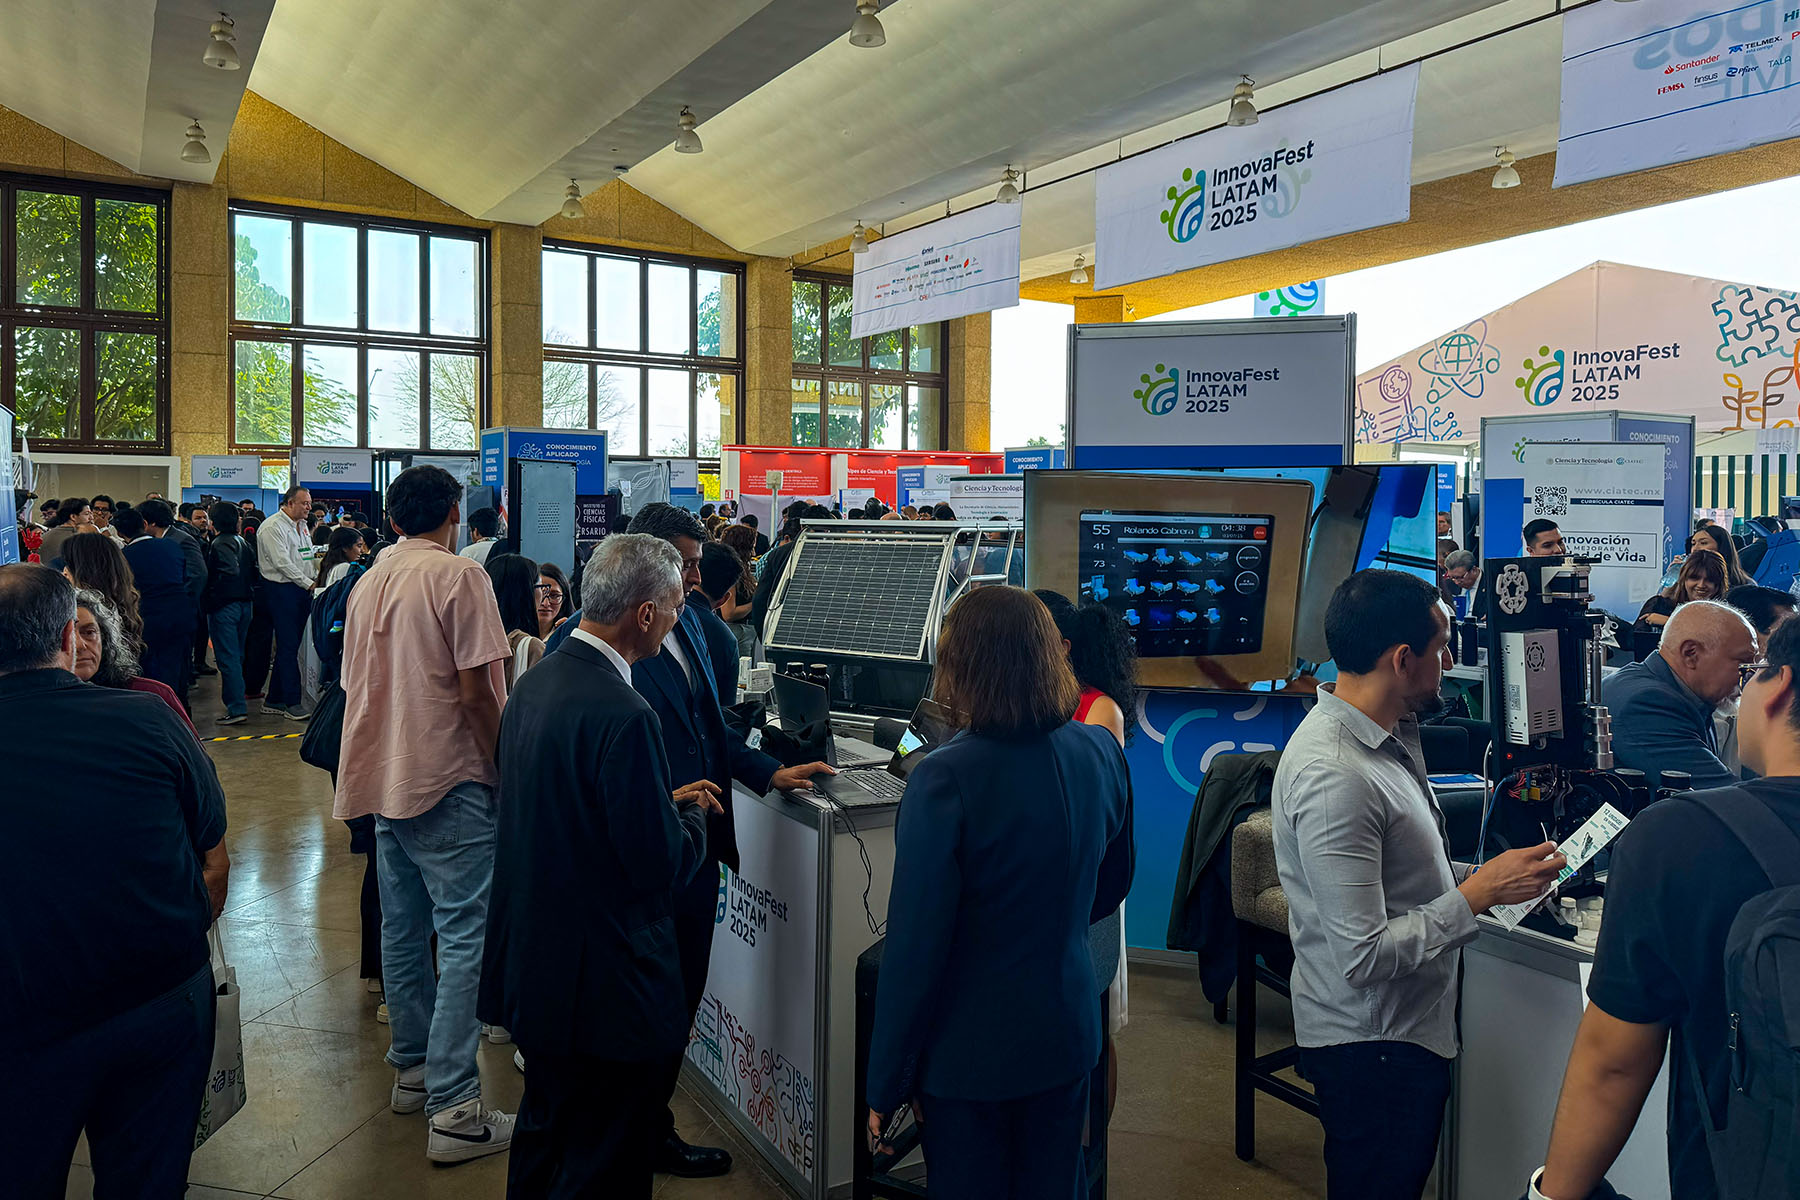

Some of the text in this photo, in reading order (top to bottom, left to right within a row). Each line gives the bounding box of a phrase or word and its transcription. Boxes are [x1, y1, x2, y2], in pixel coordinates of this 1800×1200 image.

[1675, 54, 1720, 72] Santander
[1694, 72, 1718, 84] finsus
[1738, 65, 1759, 77] Pfizer
[1657, 82, 1685, 95] FEMSA
[1213, 140, 1314, 187] InnovaFest
[1212, 174, 1277, 209] LATAM
[1210, 202, 1257, 231] 2025
[1573, 343, 1680, 365] InnovaFest
[1186, 368, 1279, 382] InnovaFest
[1572, 364, 1640, 384] LATAM
[1186, 384, 1247, 398] LATAM
[1571, 384, 1619, 402] 2025
[1185, 400, 1229, 413] 2025
[1630, 432, 1680, 444] CONOCIMIENTO
[1581, 457, 1613, 465] Tecnología
[1574, 486, 1660, 496] www.ciatec.mx
[1092, 524, 1110, 535] 55
[1123, 526, 1194, 536] Rolando Cabrera
[1561, 535, 1630, 545] nnovación
[1615, 552, 1646, 562] Vida
[731, 871, 788, 922] InnovaFest
[731, 891, 767, 933] LATAM
[730, 913, 756, 948] 2025
